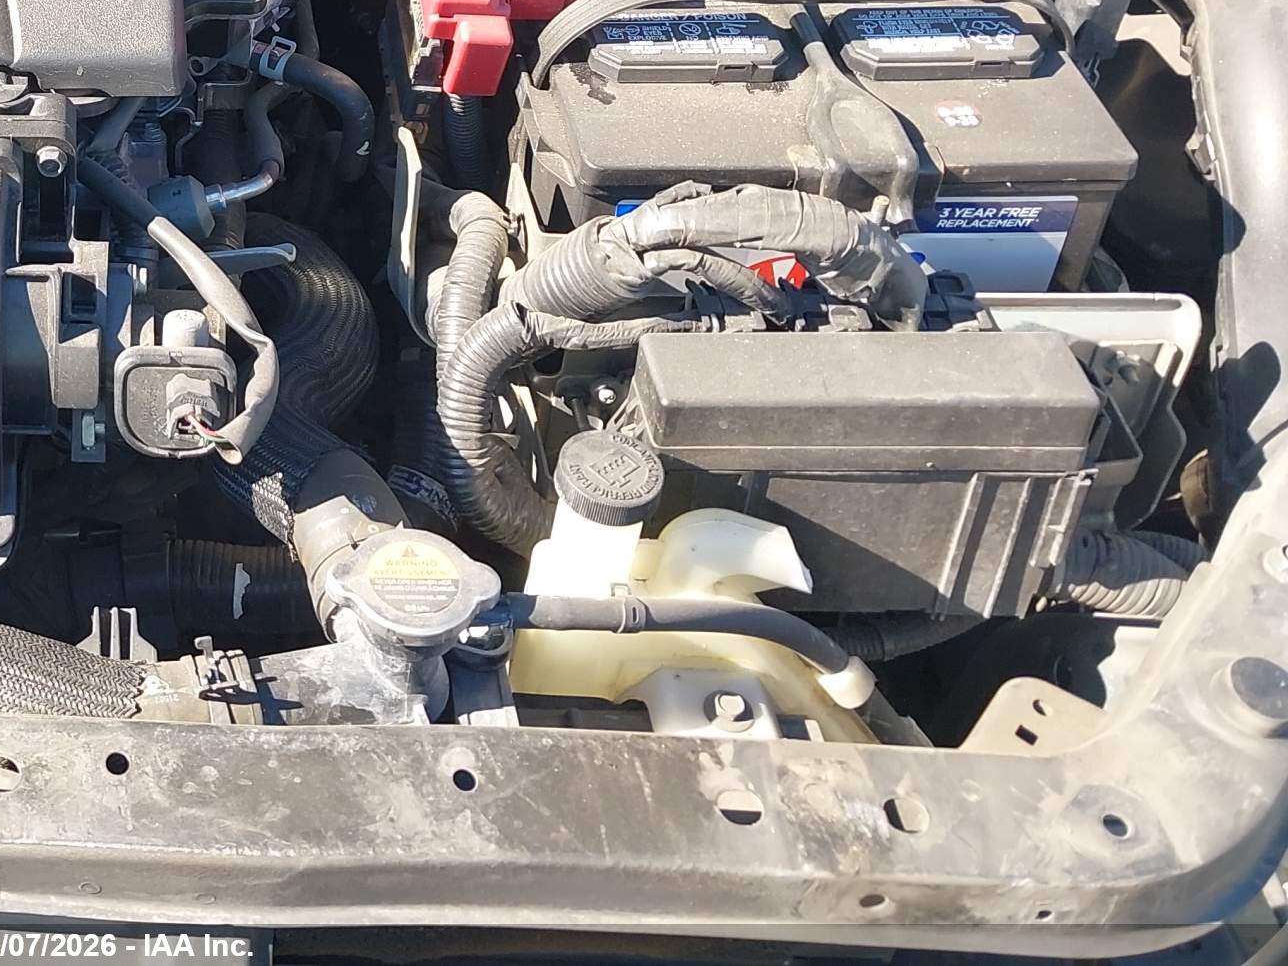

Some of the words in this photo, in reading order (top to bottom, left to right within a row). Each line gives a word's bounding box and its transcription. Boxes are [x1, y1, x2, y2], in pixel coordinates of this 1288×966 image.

[694, 13, 748, 21] POISON
[939, 208, 952, 218] 3
[954, 207, 997, 218] YEAR
[997, 207, 1043, 218] FREE
[385, 559, 438, 567] WARNING
